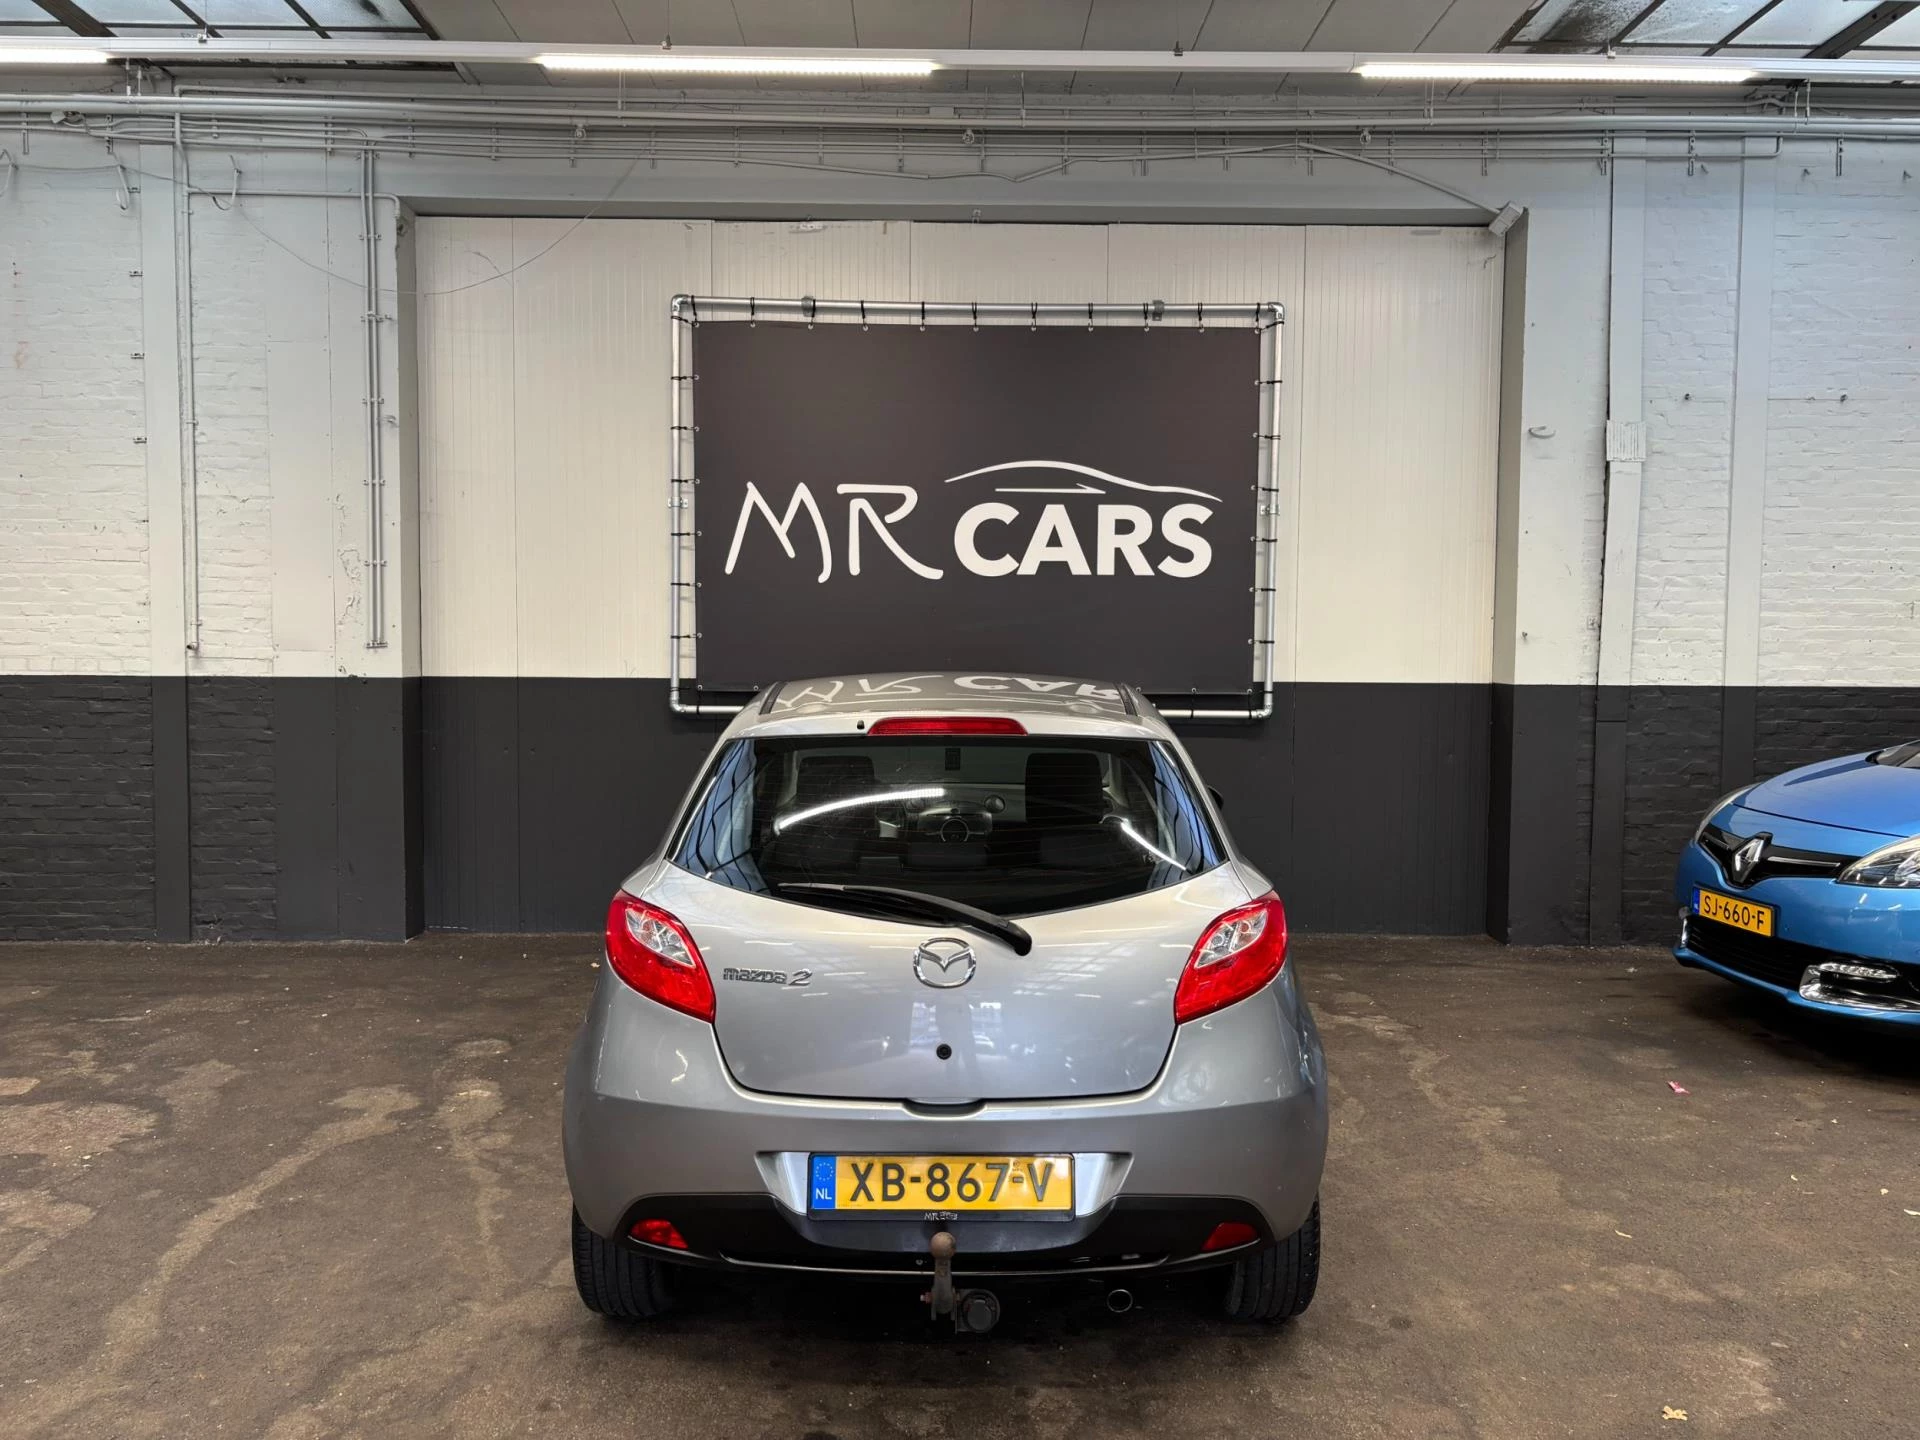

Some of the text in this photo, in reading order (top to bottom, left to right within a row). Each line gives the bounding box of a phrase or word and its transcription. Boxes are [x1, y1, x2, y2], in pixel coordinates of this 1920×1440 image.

[725, 481, 1214, 583] MR CARS
[1703, 895, 1765, 931] SJ-660-F
[788, 968, 813, 986] 2
[815, 1187, 833, 1200] NL
[850, 1162, 1053, 1202] XB-867-V
